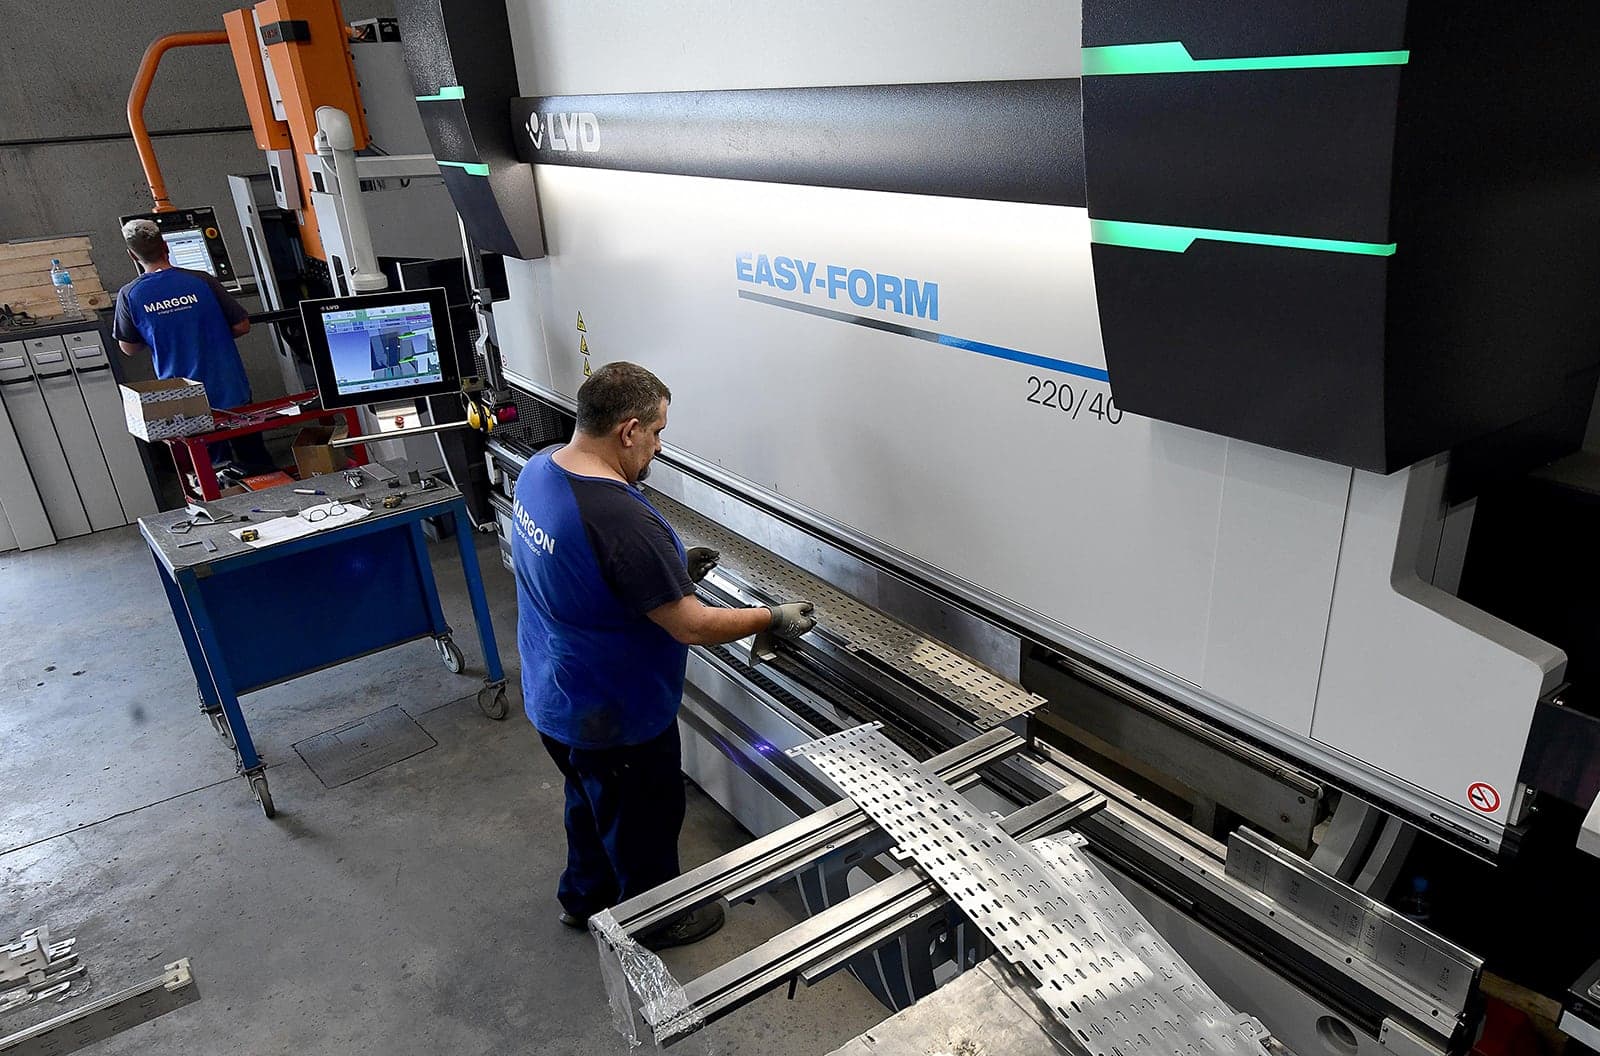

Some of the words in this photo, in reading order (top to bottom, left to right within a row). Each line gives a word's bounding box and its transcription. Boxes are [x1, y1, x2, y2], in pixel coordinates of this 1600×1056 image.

[547, 112, 601, 152] LVD
[143, 293, 199, 313] MARGON
[736, 251, 939, 322] EASY-FORM
[1027, 376, 1123, 425] 220/40
